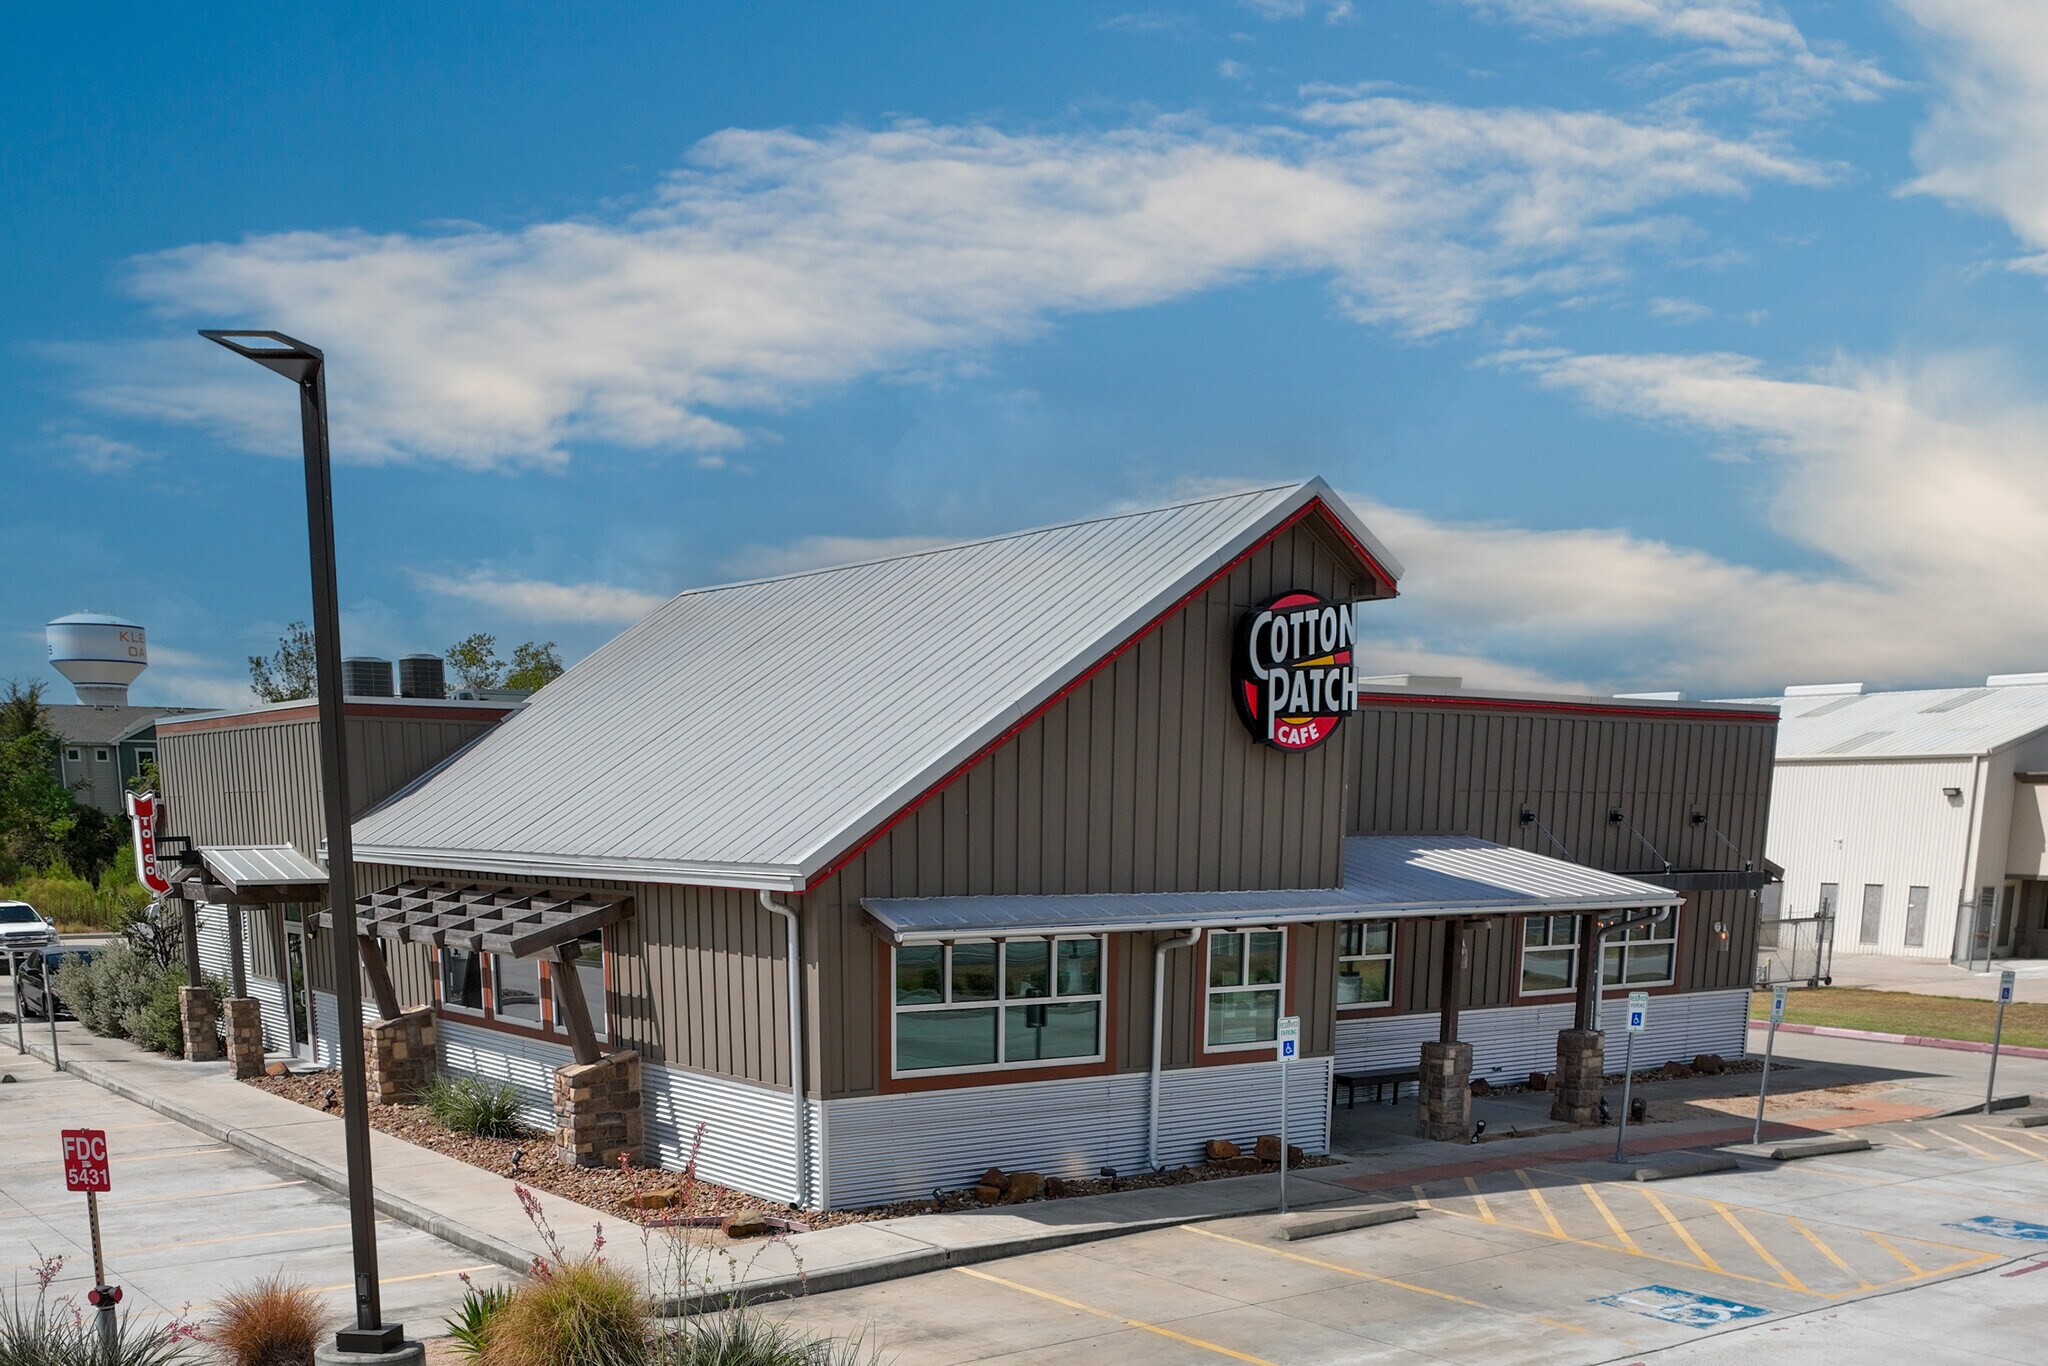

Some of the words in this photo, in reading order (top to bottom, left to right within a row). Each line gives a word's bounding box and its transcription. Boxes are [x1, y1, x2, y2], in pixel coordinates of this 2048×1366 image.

[1249, 604, 1358, 680] COTTON
[1268, 666, 1359, 740] PATCH
[1277, 722, 1320, 745] CAFE
[63, 1136, 106, 1161] FDC
[68, 1168, 109, 1185] 5431
